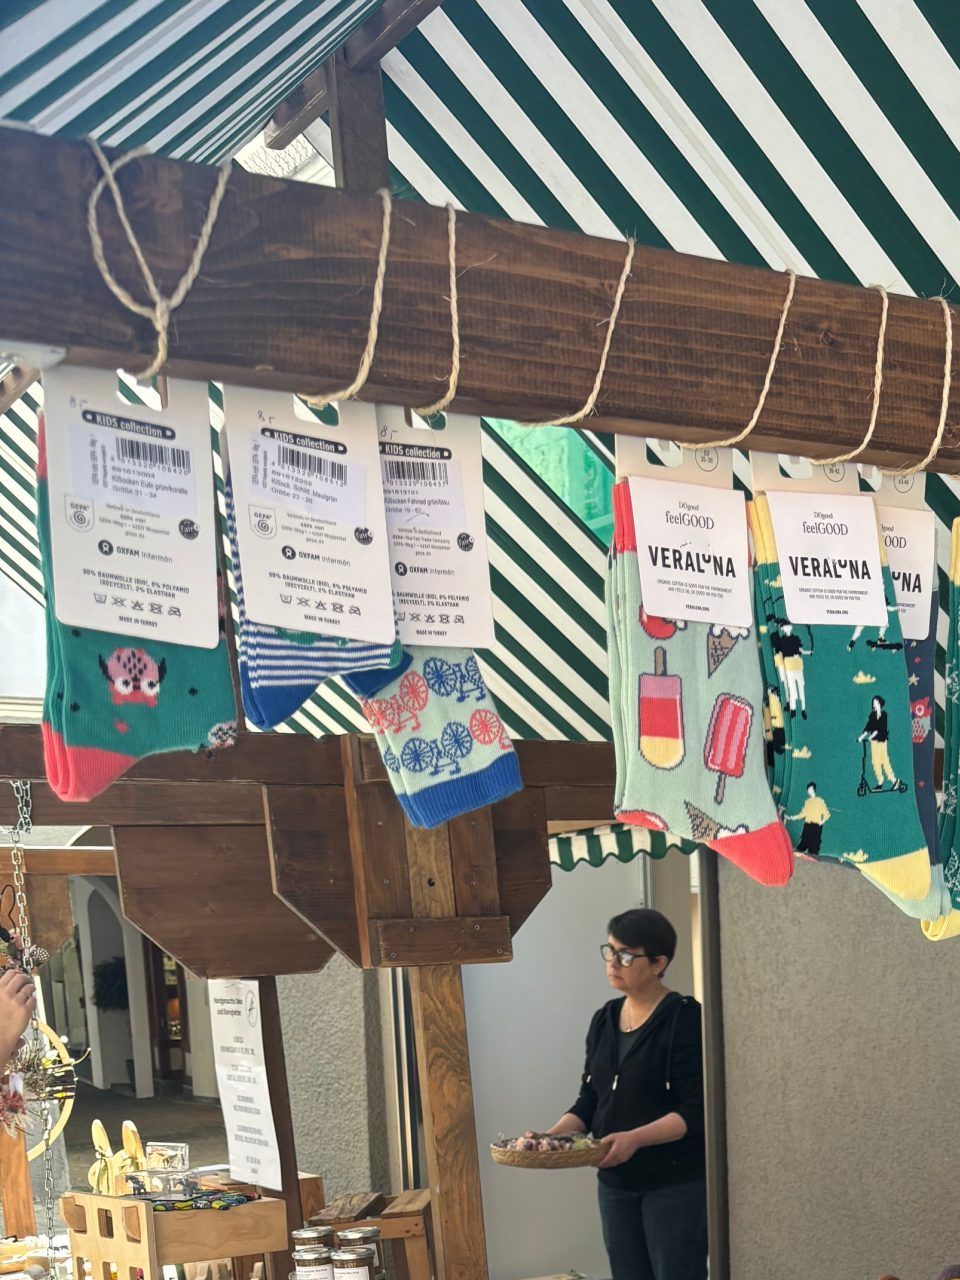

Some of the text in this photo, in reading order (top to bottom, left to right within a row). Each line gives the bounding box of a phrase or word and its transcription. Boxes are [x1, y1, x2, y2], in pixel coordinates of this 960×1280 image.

[96, 413, 163, 438] KIDS collection
[273, 431, 335, 452] KIDS collection
[385, 445, 441, 459] KIDS collection
[271, 487, 291, 498] Größe
[678, 501, 700, 512] DOgood
[665, 511, 715, 530] feelGOOD
[802, 522, 849, 536] feelGOOD
[116, 546, 173, 564] OXFAM Intermón
[298, 551, 351, 567] OXFAM Intermón
[648, 545, 737, 579] VERALUNA
[789, 556, 872, 580] VERALUNA
[98, 571, 133, 583] BAUMWOLLE
[162, 583, 190, 594] POLYAMID
[283, 574, 315, 585] BAUMWOLLE
[342, 585, 368, 595] POLYAMID
[119, 615, 133, 623] MADE
[140, 618, 158, 628] TURKEY
[324, 617, 341, 625] TURKEY
